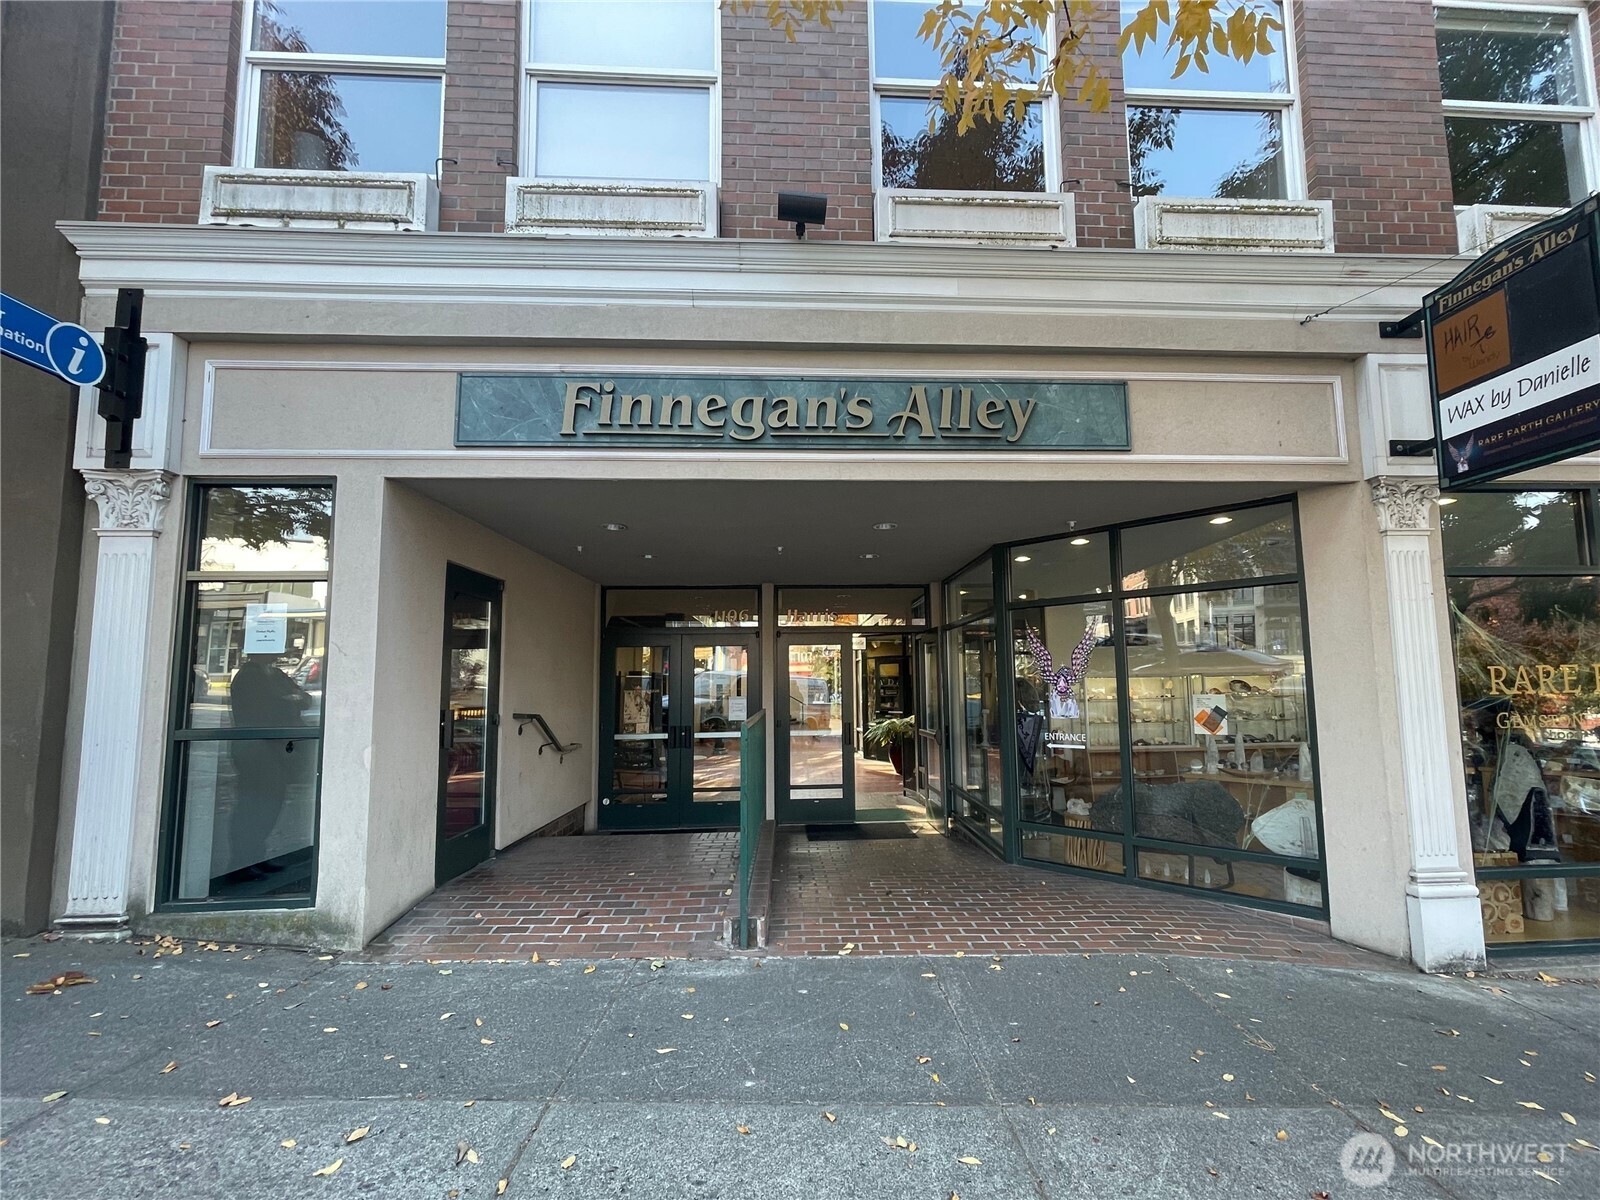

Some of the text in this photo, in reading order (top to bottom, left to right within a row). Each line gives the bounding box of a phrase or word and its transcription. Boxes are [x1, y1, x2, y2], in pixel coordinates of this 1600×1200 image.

[1436, 223, 1579, 314] Finnegan's Alley
[1444, 314, 1480, 355] HAIR
[1447, 354, 1591, 424] WAX by Danielle
[559, 381, 1037, 442] Finnegan's Alley
[780, 608, 838, 625] Harris
[1487, 663, 1582, 695] RARE
[1044, 732, 1086, 742] ENTRANCE
